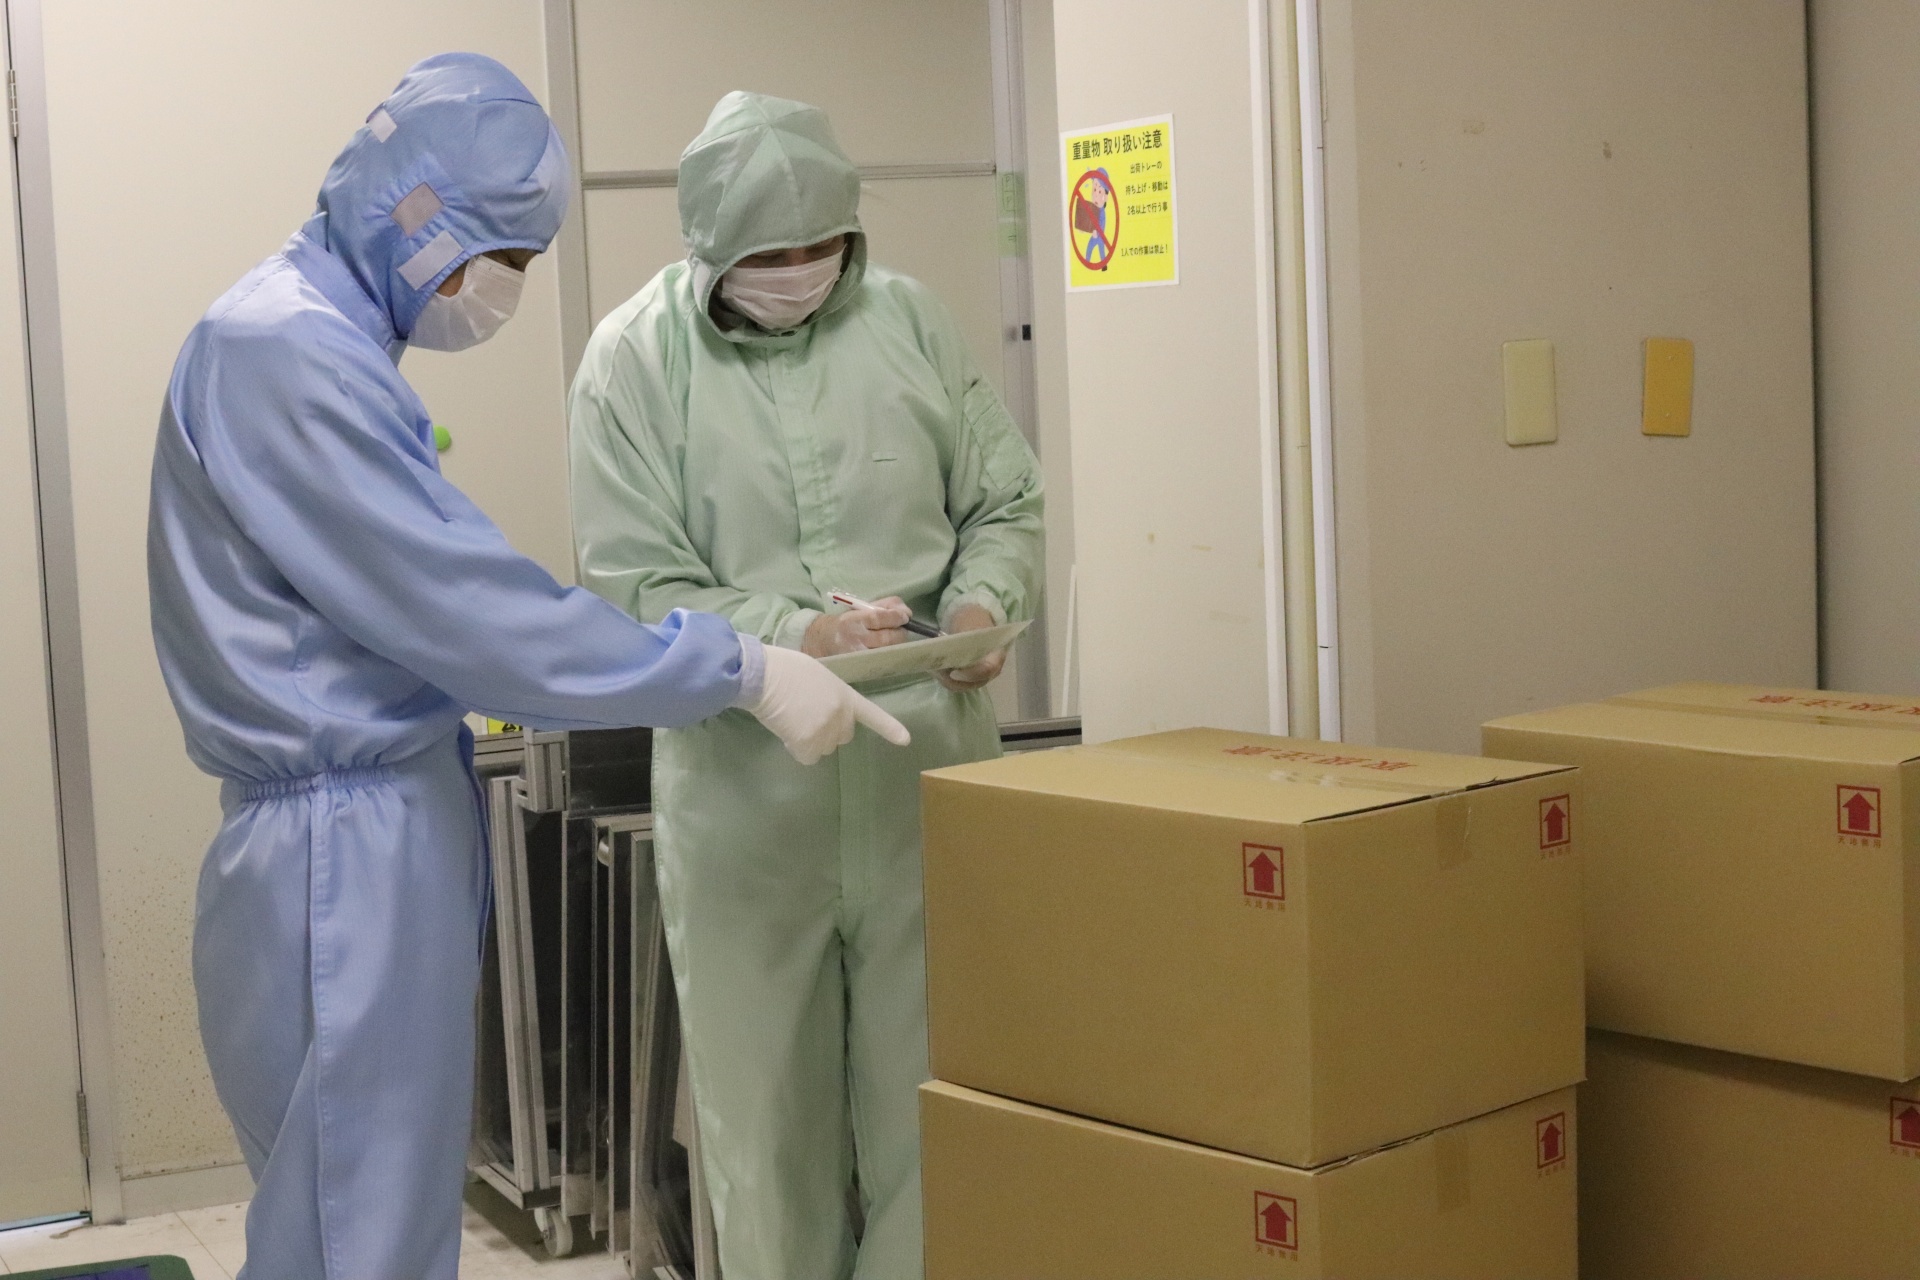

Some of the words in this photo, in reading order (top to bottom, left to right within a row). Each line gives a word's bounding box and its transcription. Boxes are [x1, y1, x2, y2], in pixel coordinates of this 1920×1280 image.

[1073, 139, 1100, 160] 重量物
[1103, 129, 1162, 156] 取り扱い注意
[1130, 161, 1162, 174] 出荷トレーの
